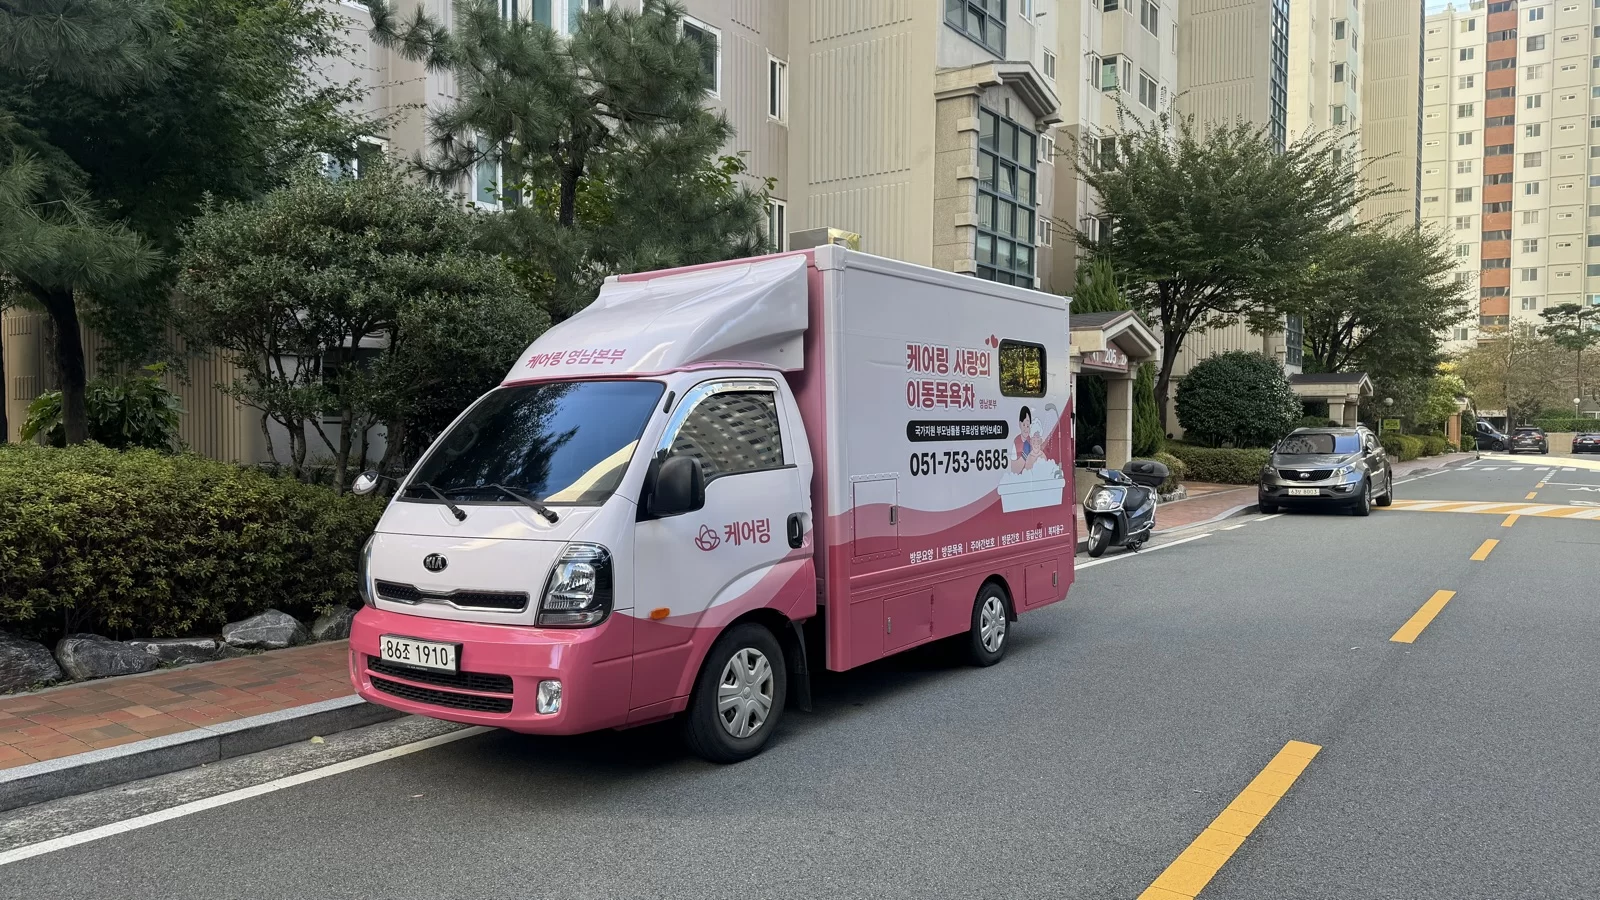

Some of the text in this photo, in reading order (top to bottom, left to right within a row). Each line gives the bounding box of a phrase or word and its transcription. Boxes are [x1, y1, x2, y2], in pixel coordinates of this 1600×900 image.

[525, 348, 627, 369] 케어링 영남본부
[905, 343, 991, 377] 케어링 사랑의
[906, 380, 998, 410] 이동목욕차 영남본부
[915, 425, 936, 437] 국가지원
[909, 448, 1009, 477] 051-753-6585
[723, 517, 771, 546] 케어링
[425, 556, 443, 569] KIA
[909, 548, 934, 565] 방문요양
[941, 542, 963, 558] 방문목욕
[970, 537, 995, 552] 주야간보호
[1001, 532, 1020, 546] 방문간호
[386, 640, 448, 666] 86조 1910
